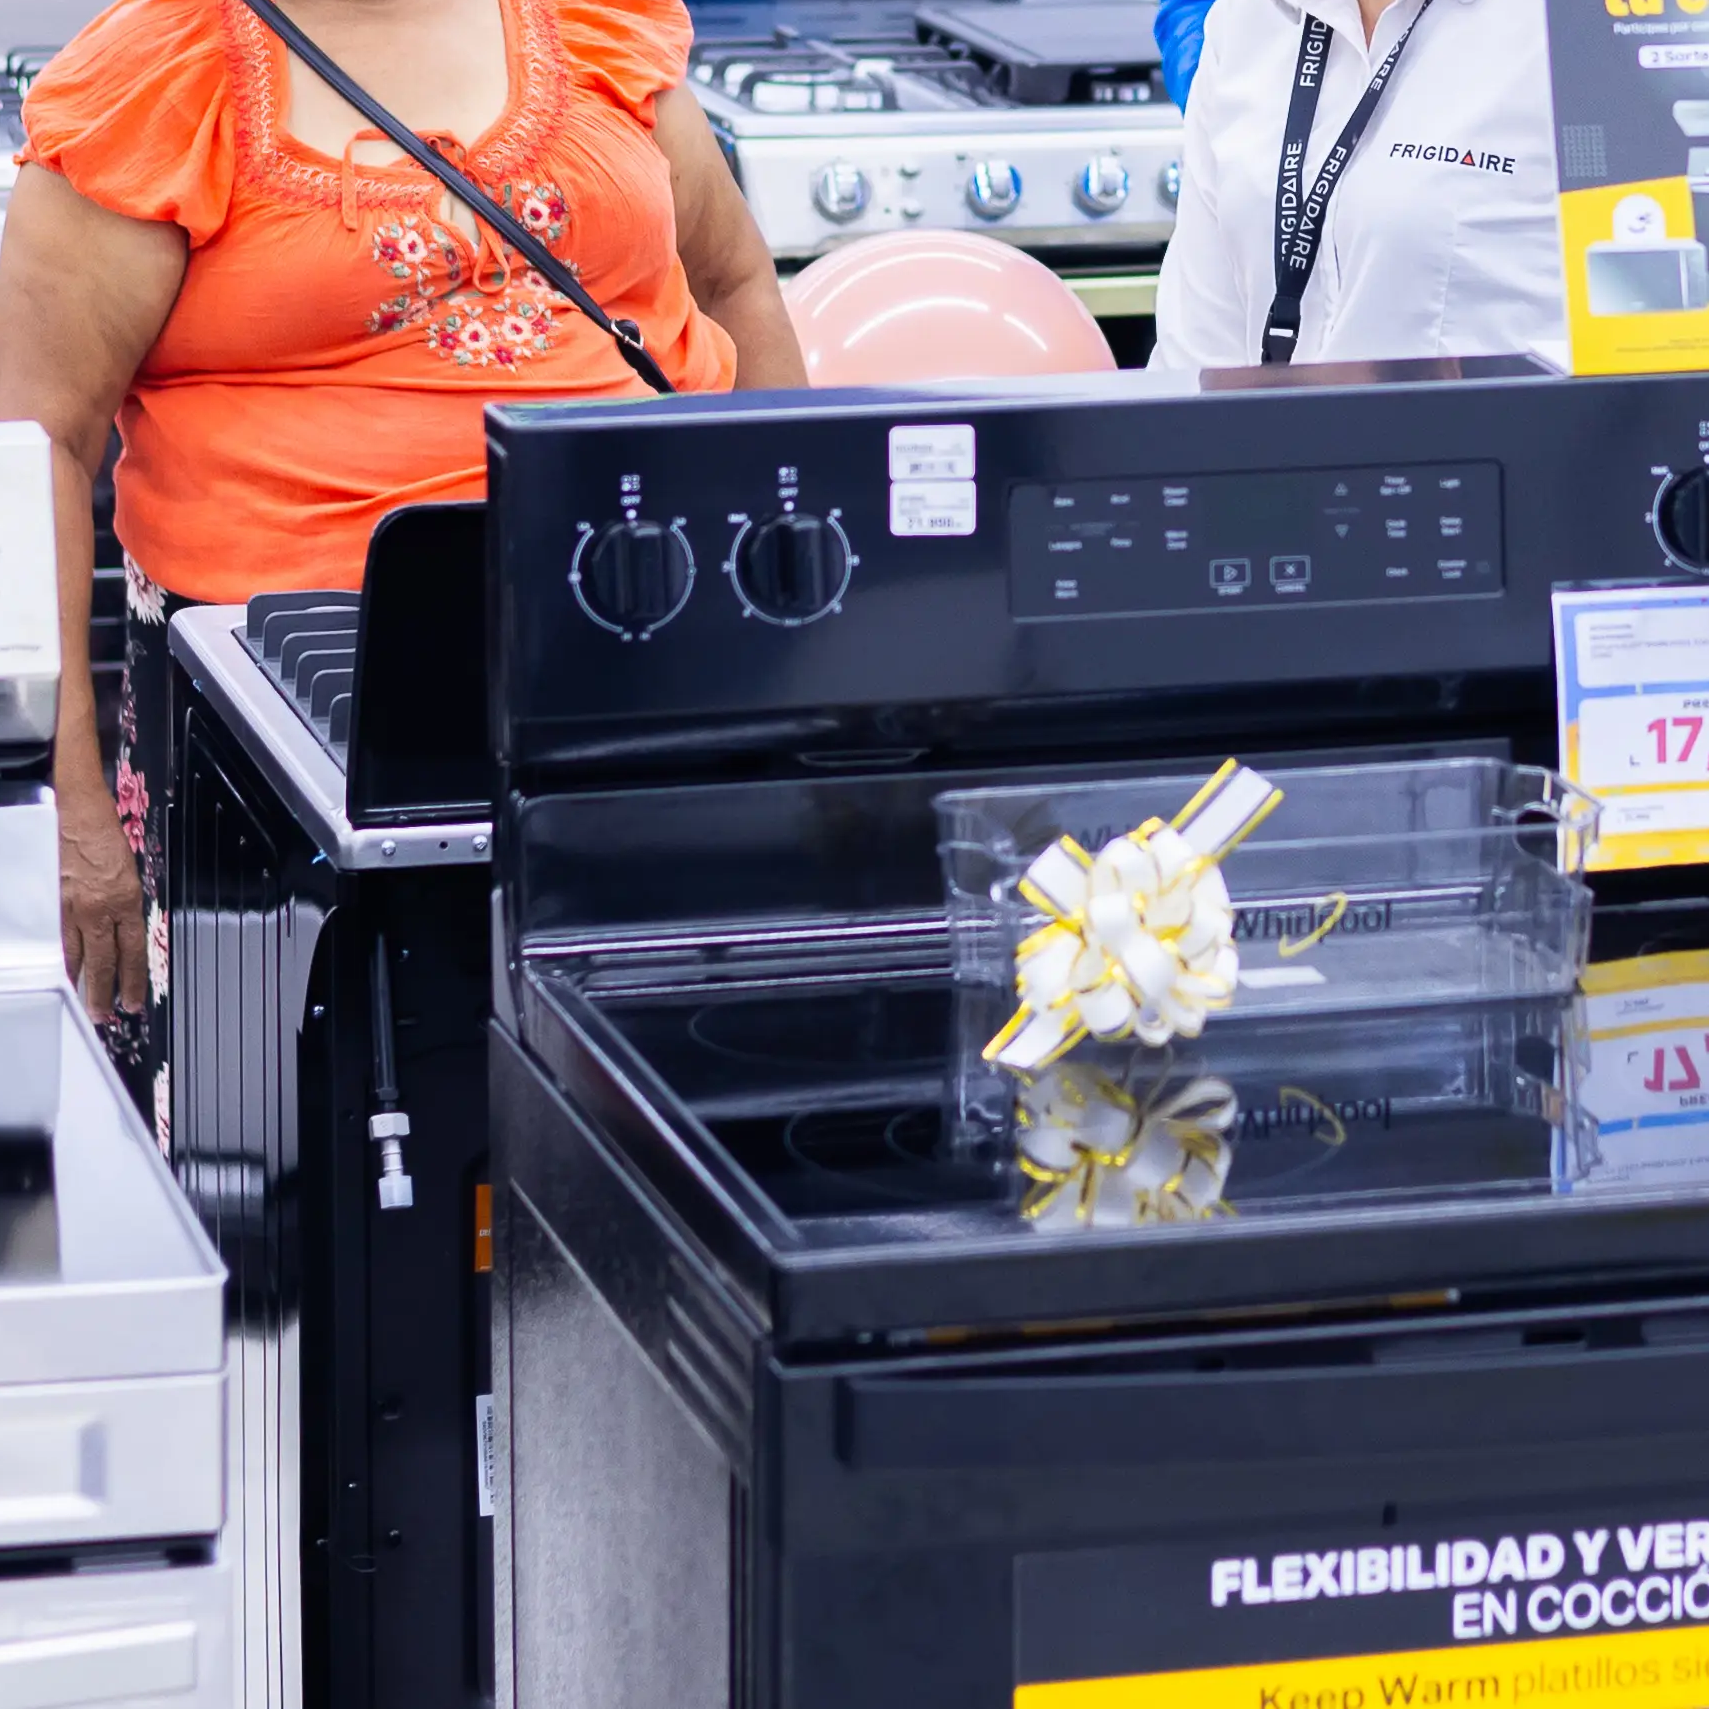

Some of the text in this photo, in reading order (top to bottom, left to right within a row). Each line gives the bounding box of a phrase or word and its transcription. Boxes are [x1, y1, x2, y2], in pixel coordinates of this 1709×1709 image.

[1390, 143, 1516, 175] FRIGIDAIRE
[1289, 146, 1347, 271] FRIGIDAIRE
[1211, 1532, 1566, 1606] FLEXIBILIDAD
[1574, 1531, 1612, 1573] Y
[1451, 1589, 1519, 1640] EN
[1257, 1682, 1366, 1709] Keep
[1377, 1671, 1502, 1706] Warm
[1513, 1653, 1661, 1701] platillos
